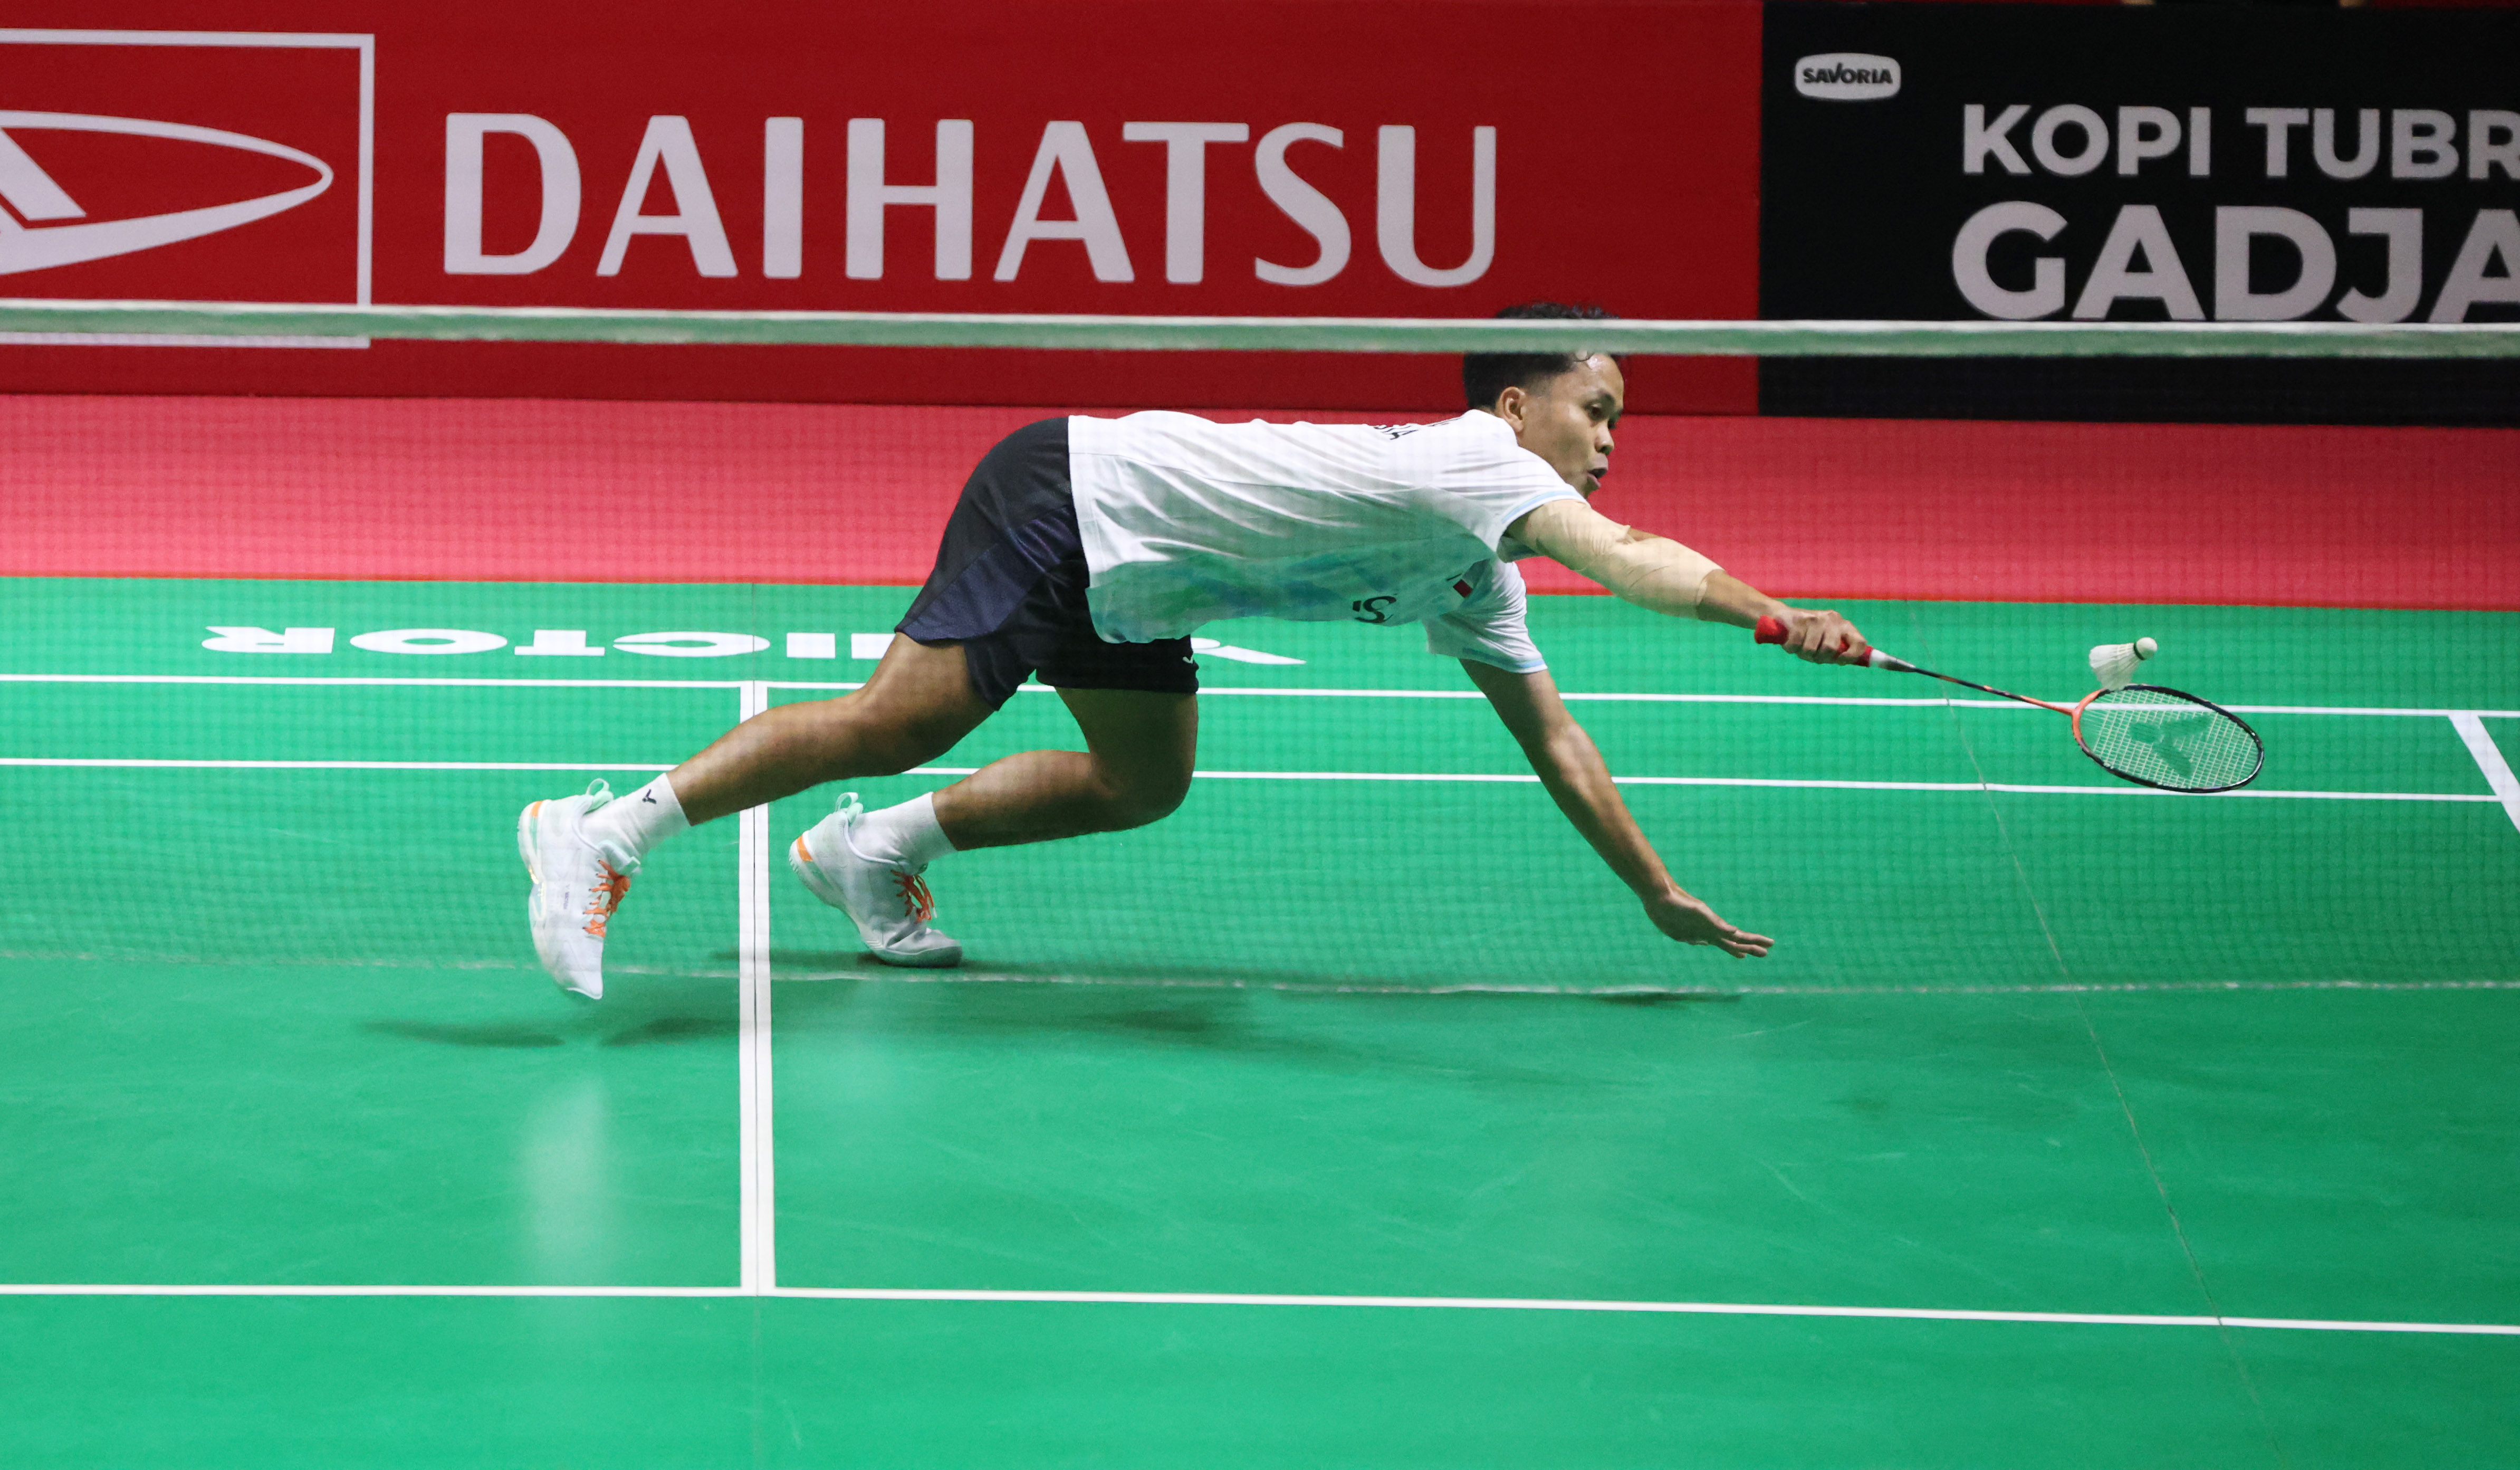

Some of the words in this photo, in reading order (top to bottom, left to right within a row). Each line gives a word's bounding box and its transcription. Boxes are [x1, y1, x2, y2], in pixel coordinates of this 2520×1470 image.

[1803, 62, 1893, 83] SAVORIA
[1963, 104, 2211, 176] KOPI
[2246, 108, 2520, 179] TUBR
[444, 112, 1497, 288] DAIHATSU
[1952, 201, 2520, 323] GADJA
